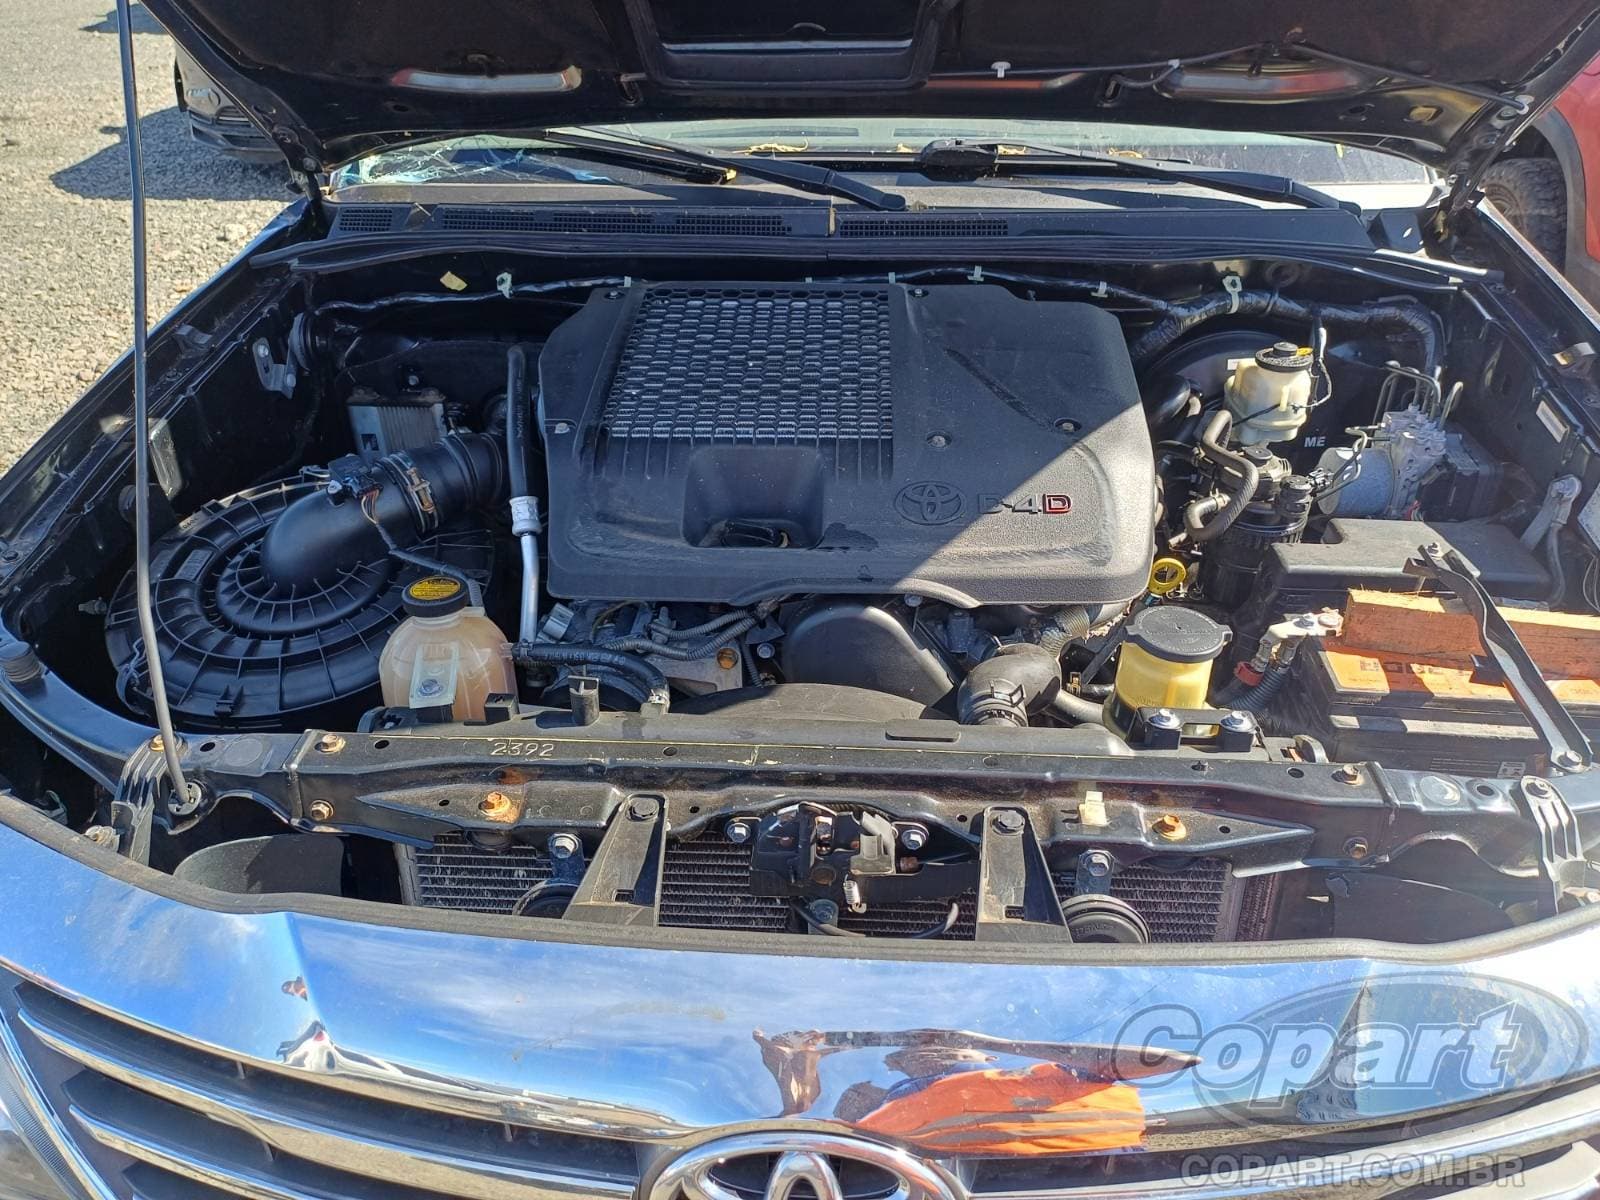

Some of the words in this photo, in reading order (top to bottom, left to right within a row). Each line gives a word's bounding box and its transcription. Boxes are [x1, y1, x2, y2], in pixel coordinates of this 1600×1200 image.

[1304, 436, 1326, 448] ME
[978, 493, 1072, 515] D-4D
[490, 742, 554, 757] 2392
